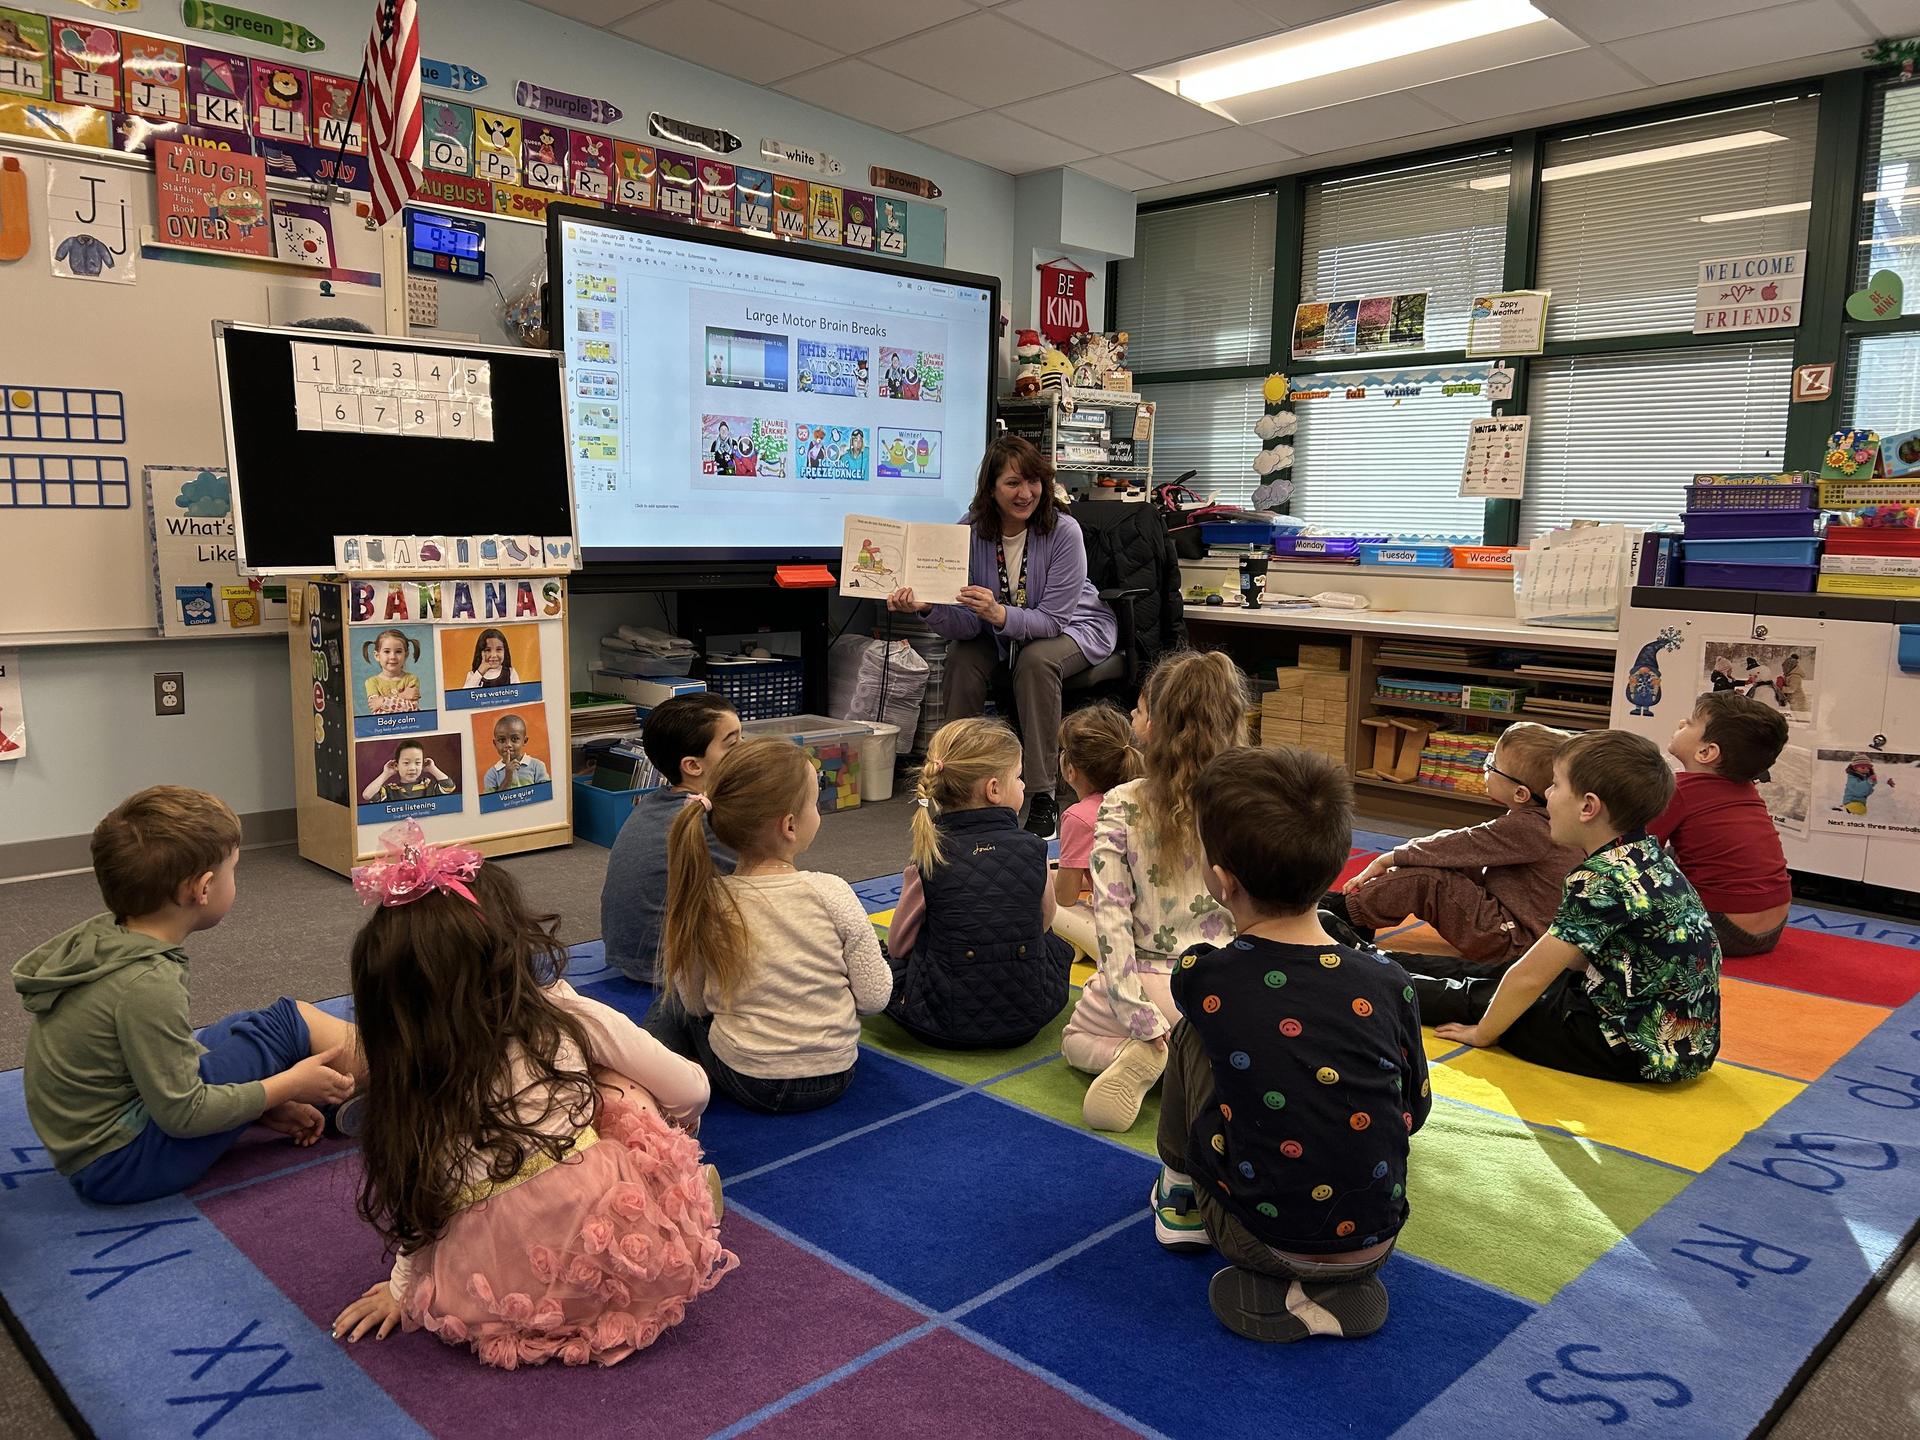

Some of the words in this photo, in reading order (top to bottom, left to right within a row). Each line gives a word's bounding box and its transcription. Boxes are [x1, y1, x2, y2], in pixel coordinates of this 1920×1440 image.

[224, 14, 273, 36] green
[231, 58, 245, 67] kite
[256, 66, 271, 75] lion
[314, 75, 337, 84] mouse
[421, 67, 439, 80] ue
[73, 72, 98, 96] Ii
[138, 83, 166, 116] Jj
[424, 98, 449, 109] octopus
[545, 96, 588, 116] purple
[206, 97, 238, 124] Kk
[273, 110, 292, 133] Ll
[323, 120, 359, 146] Mm
[677, 125, 709, 145] black
[524, 138, 541, 146] queen
[174, 146, 183, 156] If
[186, 148, 205, 158] You
[435, 143, 463, 167] Oo
[785, 150, 815, 166] white
[167, 153, 258, 188] LAUGH,
[316, 159, 356, 183] July
[488, 153, 510, 177] Pp
[532, 163, 559, 184] Qq
[175, 173, 190, 184] I'm
[579, 171, 600, 193] Rr
[888, 174, 919, 191] brown
[162, 182, 203, 196] Starting
[420, 179, 487, 206] August
[624, 181, 644, 202] Ss
[174, 193, 194, 205] This
[666, 189, 685, 208] Tt
[707, 196, 727, 217] Uu
[75, 175, 126, 255] Jj
[173, 204, 195, 214] Book
[745, 203, 763, 224] Vv
[167, 215, 231, 240] OVER
[279, 217, 293, 232] Jj
[780, 211, 804, 232] Ww
[816, 218, 836, 238] Xx
[431, 228, 472, 258] 9:31
[852, 224, 867, 247] Yy
[883, 231, 901, 250] Zz
[1705, 256, 1795, 281] WELCOME
[1058, 273, 1075, 296] BE
[1499, 300, 1519, 309] Zippy
[1869, 289, 1884, 304] BE
[1046, 296, 1083, 329] KIND
[1492, 308, 1525, 317] Weather!
[1873, 294, 1898, 317] MINE
[745, 307, 779, 327] Large
[782, 313, 817, 329] Motor
[819, 319, 849, 332] Brain
[851, 322, 887, 337] Breaks
[1704, 305, 1792, 328] FRIENDS
[799, 344, 827, 358] THIS
[836, 347, 868, 361] THAT
[312, 355, 321, 371] 1
[352, 359, 362, 375] 2
[392, 362, 403, 378] 3
[806, 357, 857, 377] WIER
[430, 365, 441, 380] 4
[467, 369, 477, 384] 5
[1290, 388, 1331, 400] summer
[1345, 387, 1366, 400] fall
[1384, 385, 1422, 398] winter
[1442, 381, 1482, 396] spring
[335, 405, 346, 420] 6
[374, 407, 386, 422] 7
[414, 410, 425, 425] 8
[451, 412, 462, 427] 9
[1474, 424, 1498, 434] WINTER
[1500, 423, 1524, 432] WORDS
[801, 468, 833, 479] FREEZE
[834, 469, 865, 480] DANCE!
[166, 518, 234, 536] What's
[198, 545, 237, 562] Like
[1296, 541, 1325, 550] Monday
[1382, 551, 1415, 560] Tuesday
[1470, 553, 1512, 563] Wednesd
[1655, 552, 1667, 587] ASSESSMEN
[226, 588, 252, 596] Tuesday
[350, 581, 562, 622] BANANAS
[470, 691, 488, 700] Eyes
[488, 688, 519, 698] watching
[377, 717, 396, 727] Body
[397, 716, 416, 724] calm
[498, 792, 517, 801] Voice
[518, 789, 535, 800] quiet
[386, 805, 403, 813] Ears
[404, 801, 436, 811] listening
[1828, 819, 1846, 827] Next,
[1847, 821, 1865, 829] stack
[1867, 823, 1887, 831] three
[1728, 1131, 1900, 1196] Qq
[70, 1216, 200, 1300] Yy
[1671, 1222, 1812, 1289] Rr
[166, 1319, 324, 1438] Xx
[1525, 1343, 1693, 1427] Ss
